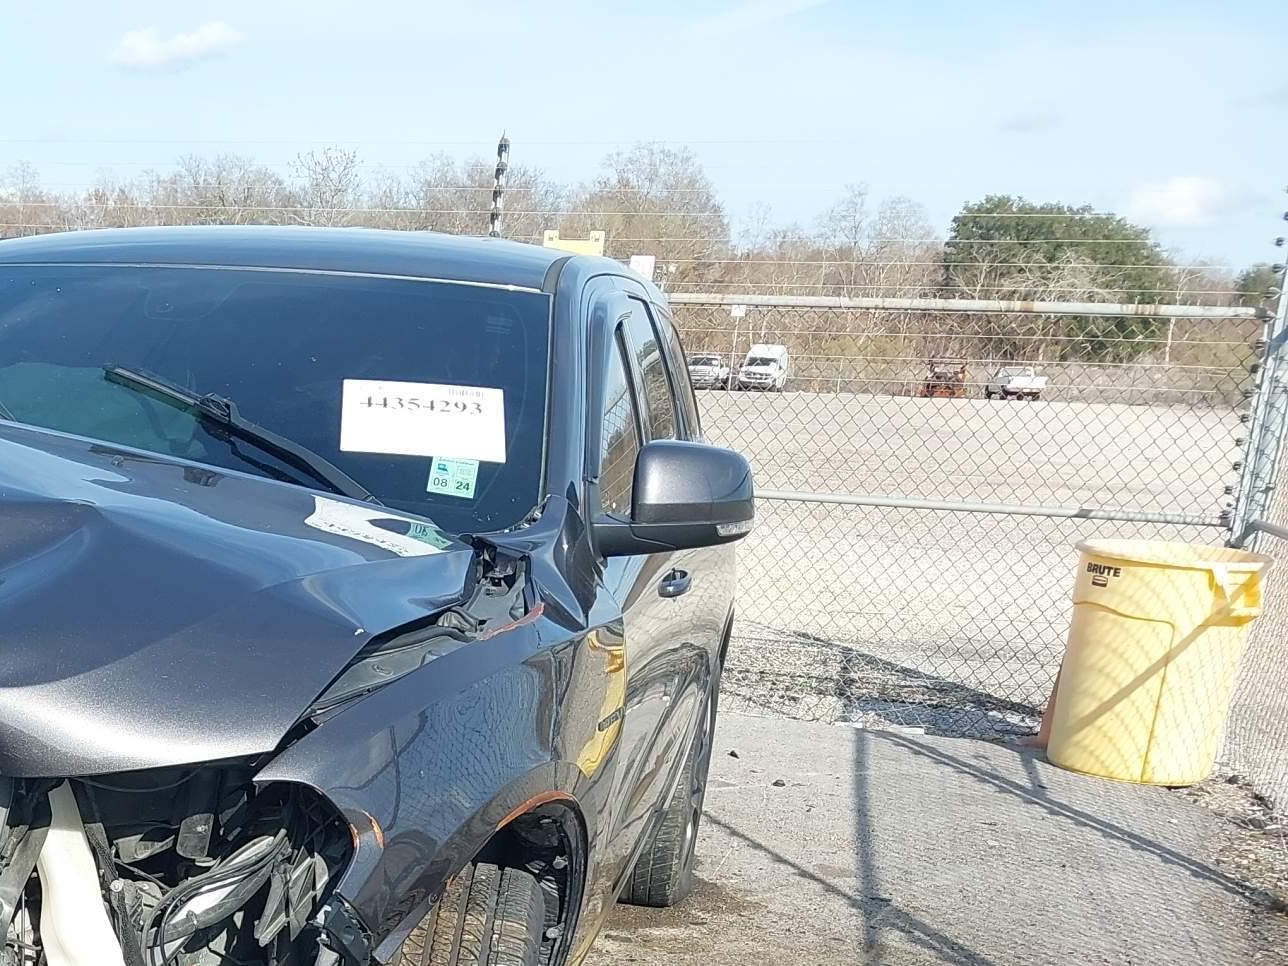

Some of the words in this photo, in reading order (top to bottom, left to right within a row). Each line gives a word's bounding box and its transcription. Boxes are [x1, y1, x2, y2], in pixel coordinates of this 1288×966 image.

[359, 396, 482, 415] 44354293
[433, 477, 448, 487] 08
[455, 480, 470, 491] 24
[1087, 562, 1121, 577] BRUTE
